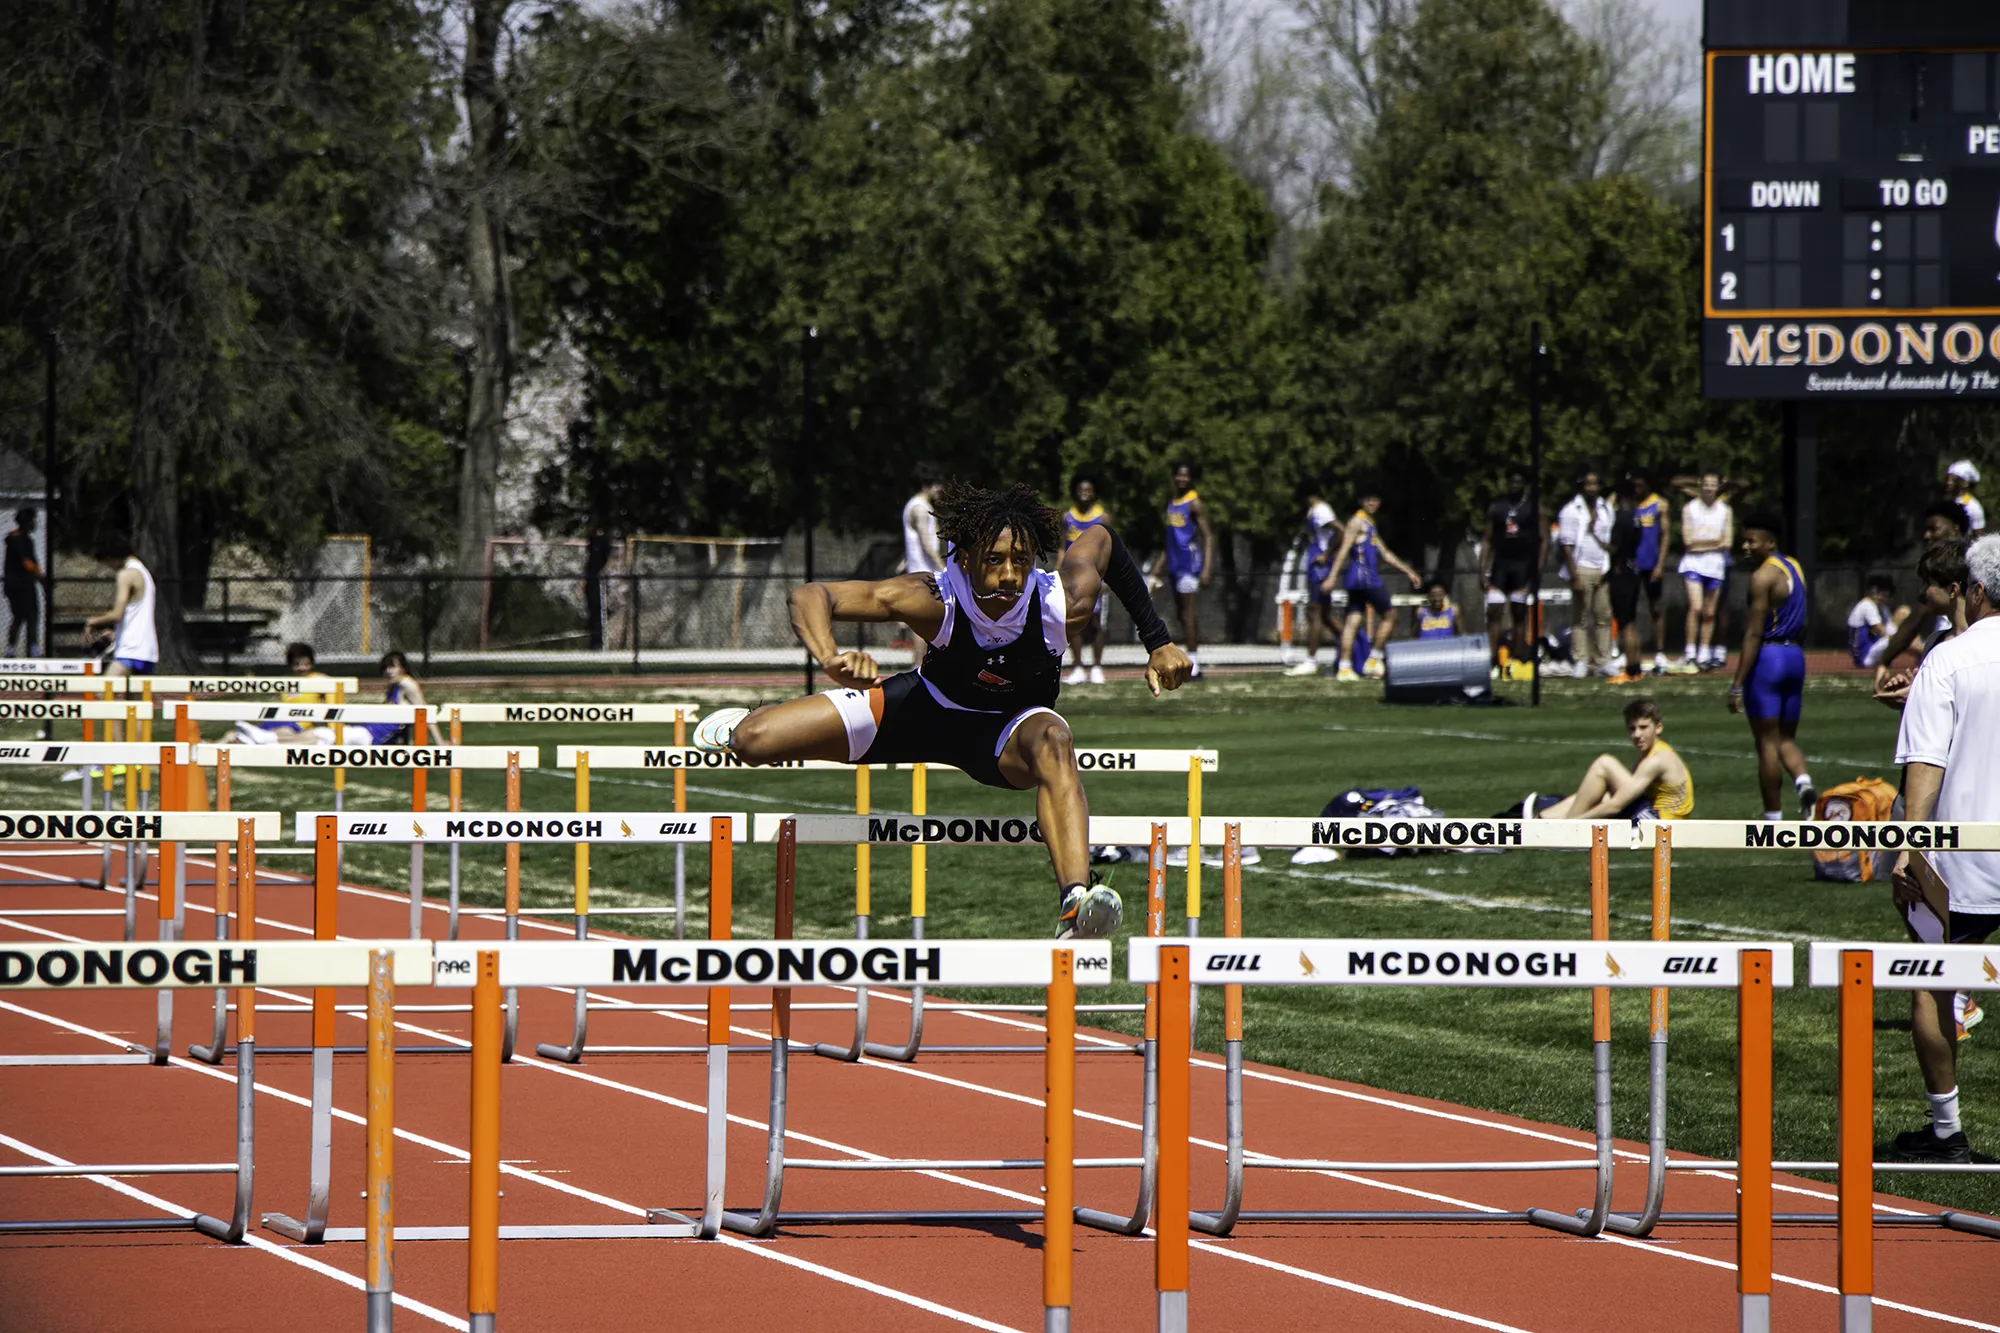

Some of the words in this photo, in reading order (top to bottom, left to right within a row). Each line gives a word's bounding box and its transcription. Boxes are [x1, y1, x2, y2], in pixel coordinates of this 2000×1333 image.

[1748, 53, 1856, 94] HOME
[1751, 181, 1820, 208] DOWN
[1880, 179, 1911, 206] TO
[1914, 179, 1948, 206] GO
[1721, 223, 1735, 251] 1
[1720, 272, 1737, 300] 2
[1806, 372, 1887, 392] Scoreboard
[1888, 371, 1948, 390] donated
[1950, 372, 1968, 395] by
[1971, 371, 2000, 390] The
[189, 680, 300, 693] McDONOGH
[505, 707, 634, 722] McDONOGH
[287, 748, 453, 767] McDONOGH
[349, 823, 388, 836] GILL
[446, 820, 603, 838] MCDONOGH
[659, 822, 698, 835] GILL
[1311, 821, 1522, 846] McDONOGH
[1745, 823, 1960, 849] McDONOGH
[612, 946, 942, 983] McDONOGH
[1206, 954, 1262, 972] GILL
[1347, 950, 1578, 977] MCDONOGH
[1663, 956, 1719, 974] GILL
[1888, 959, 1945, 977] GILL
